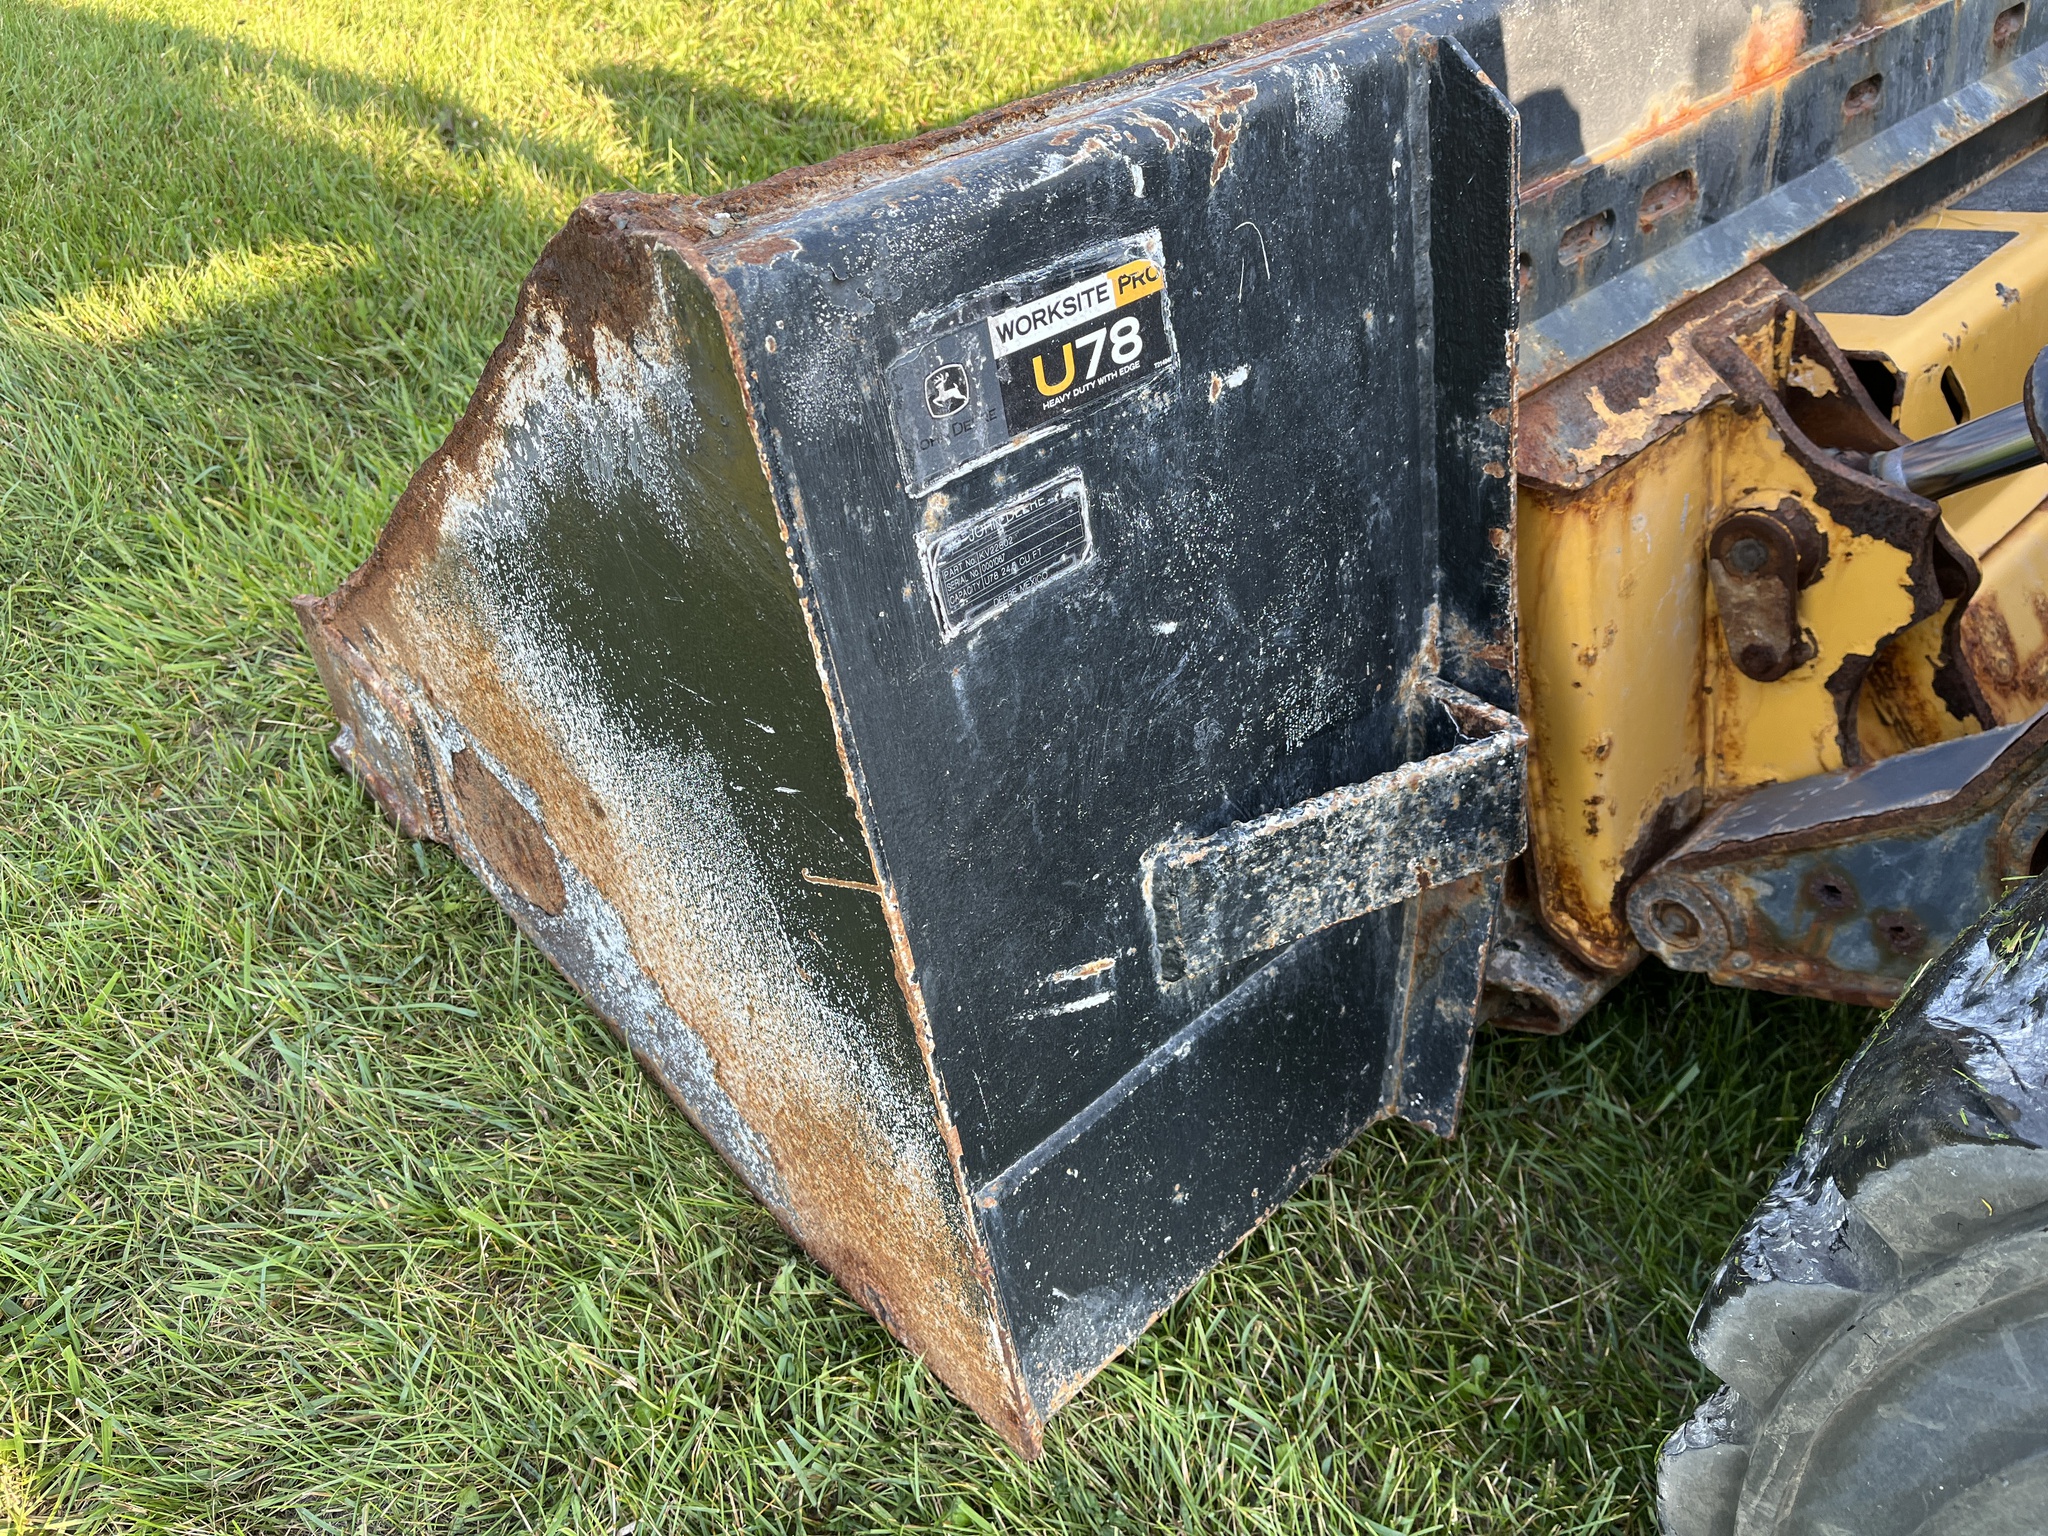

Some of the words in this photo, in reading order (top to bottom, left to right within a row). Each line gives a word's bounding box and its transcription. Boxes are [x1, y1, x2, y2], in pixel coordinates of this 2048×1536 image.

[995, 281, 1110, 344] WORKSITE
[1032, 316, 1143, 397] U78
[1042, 392, 1071, 411] HEAVY
[1072, 380, 1096, 397] DUTY
[1096, 370, 1118, 386] WITH
[1118, 360, 1141, 376] EDGE
[943, 562, 963, 580] PART
[946, 575, 969, 592] SERIAL
[949, 580, 981, 605] CAPACITY
[983, 571, 999, 586] U78
[1019, 553, 1031, 566] CU
[1032, 546, 1042, 560] FT
[993, 586, 1017, 607] DEERE
[1018, 571, 1048, 593] MEXICO
